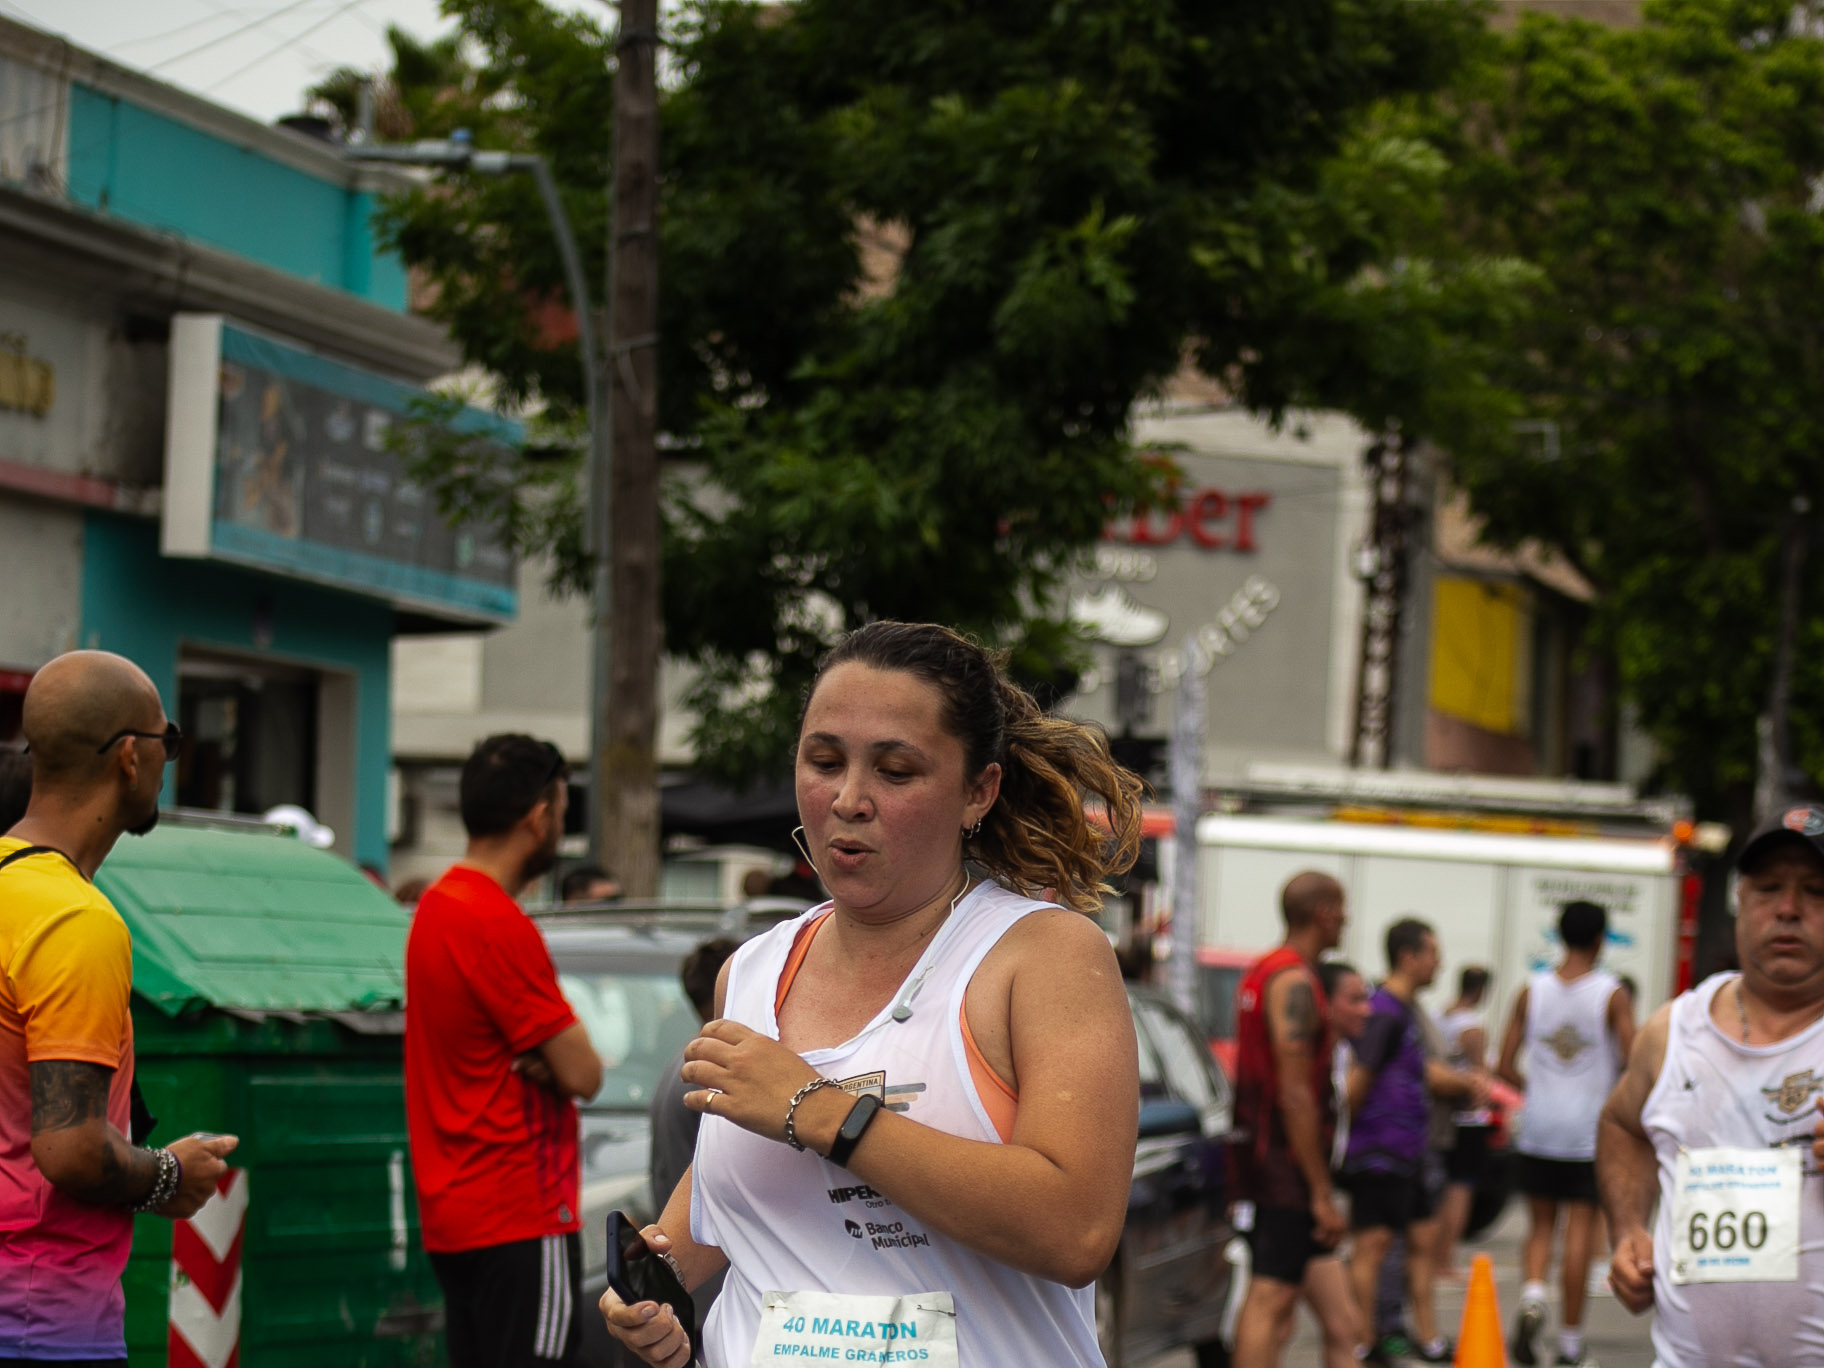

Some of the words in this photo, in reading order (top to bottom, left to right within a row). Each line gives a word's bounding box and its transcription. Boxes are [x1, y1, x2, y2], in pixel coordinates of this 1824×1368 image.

[842, 1077, 879, 1092] RGENTINA
[865, 1221, 904, 1236] Banco
[1688, 1210, 1768, 1252] 660
[871, 1232, 931, 1251] Municipal
[783, 1316, 806, 1333] 40
[811, 1317, 918, 1341] MARATON
[773, 1343, 840, 1360] EMPALME
[845, 1347, 929, 1364] GRANEROS
